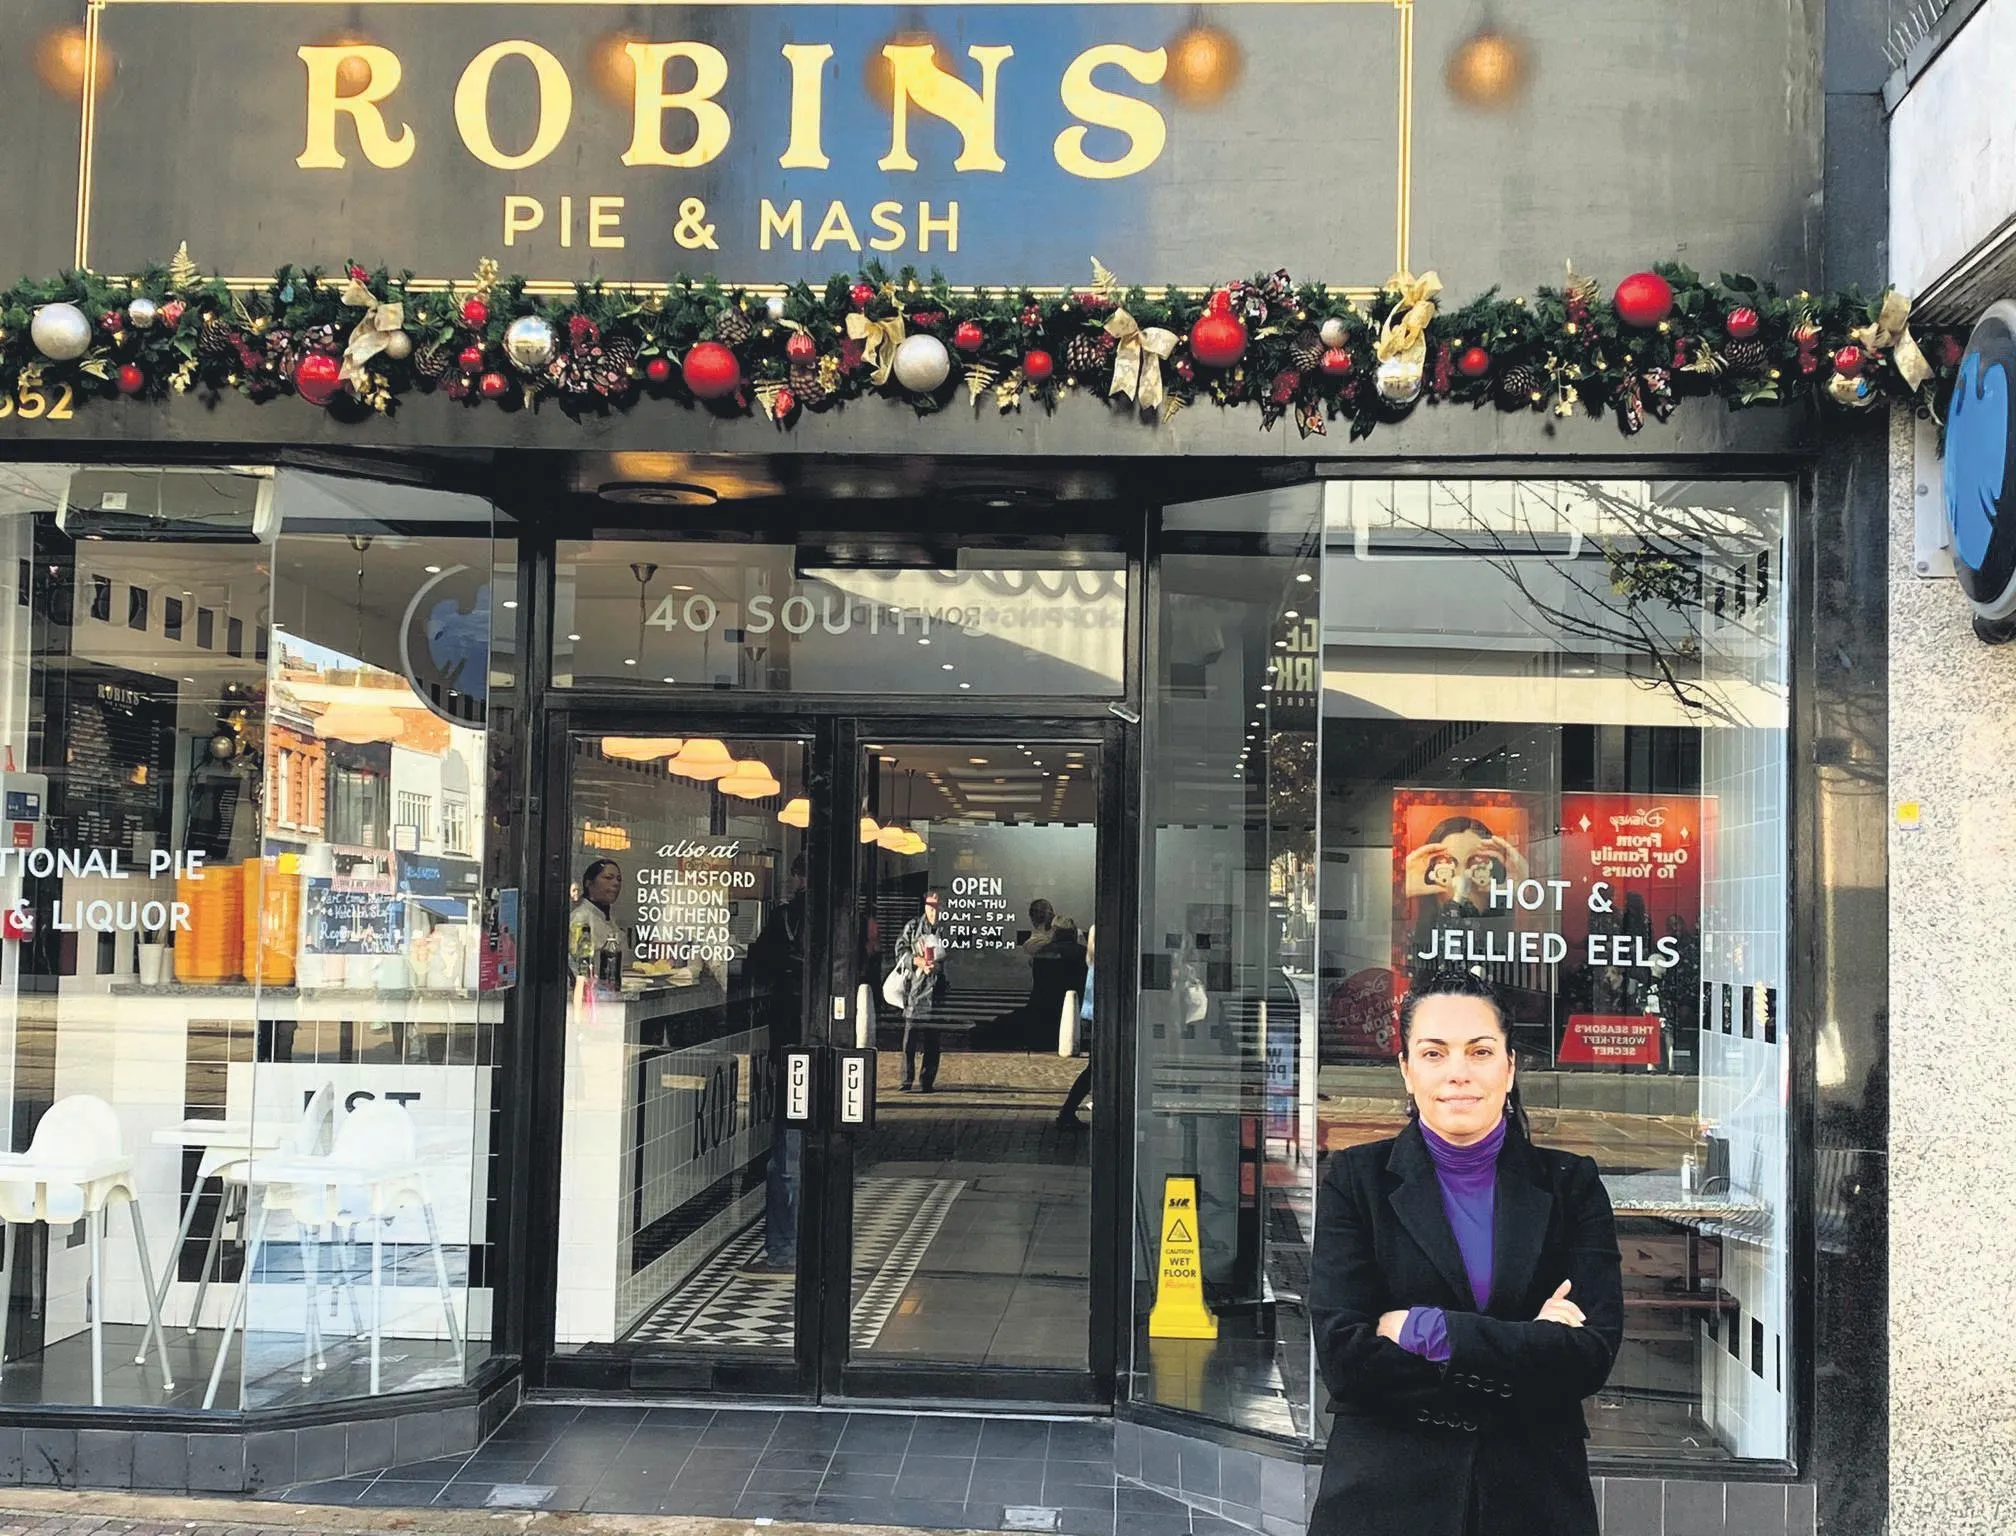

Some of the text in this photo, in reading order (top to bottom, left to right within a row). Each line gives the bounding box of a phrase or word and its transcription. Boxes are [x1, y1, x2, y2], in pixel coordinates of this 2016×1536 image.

[296, 40, 1168, 179] ROBINS
[503, 196, 960, 252] PIE & MASH
[645, 594, 932, 635] 40 SOUTH
[656, 840, 739, 859] also at
[149, 849, 206, 880] PIE
[637, 869, 756, 888] CHELMSFORD
[952, 877, 1002, 896] OPEN
[637, 888, 724, 906] BASILDON
[948, 899, 1007, 909] MON-THU
[1489, 879, 1613, 913] HOT &
[9, 900, 193, 932] & LIQUOR
[638, 906, 731, 925] SOUTHEND
[636, 925, 730, 943] WANSTEAD
[950, 926, 970, 936] FRI
[980, 926, 1004, 936] SAT
[634, 943, 735, 961] CHINGFORD
[1417, 929, 1680, 968] JELLIED EELS
[793, 1060, 803, 1113] PULL
[848, 1063, 858, 1117] PULL
[1169, 1258, 1190, 1266] WET
[1163, 1269, 1196, 1278] FLOOR
